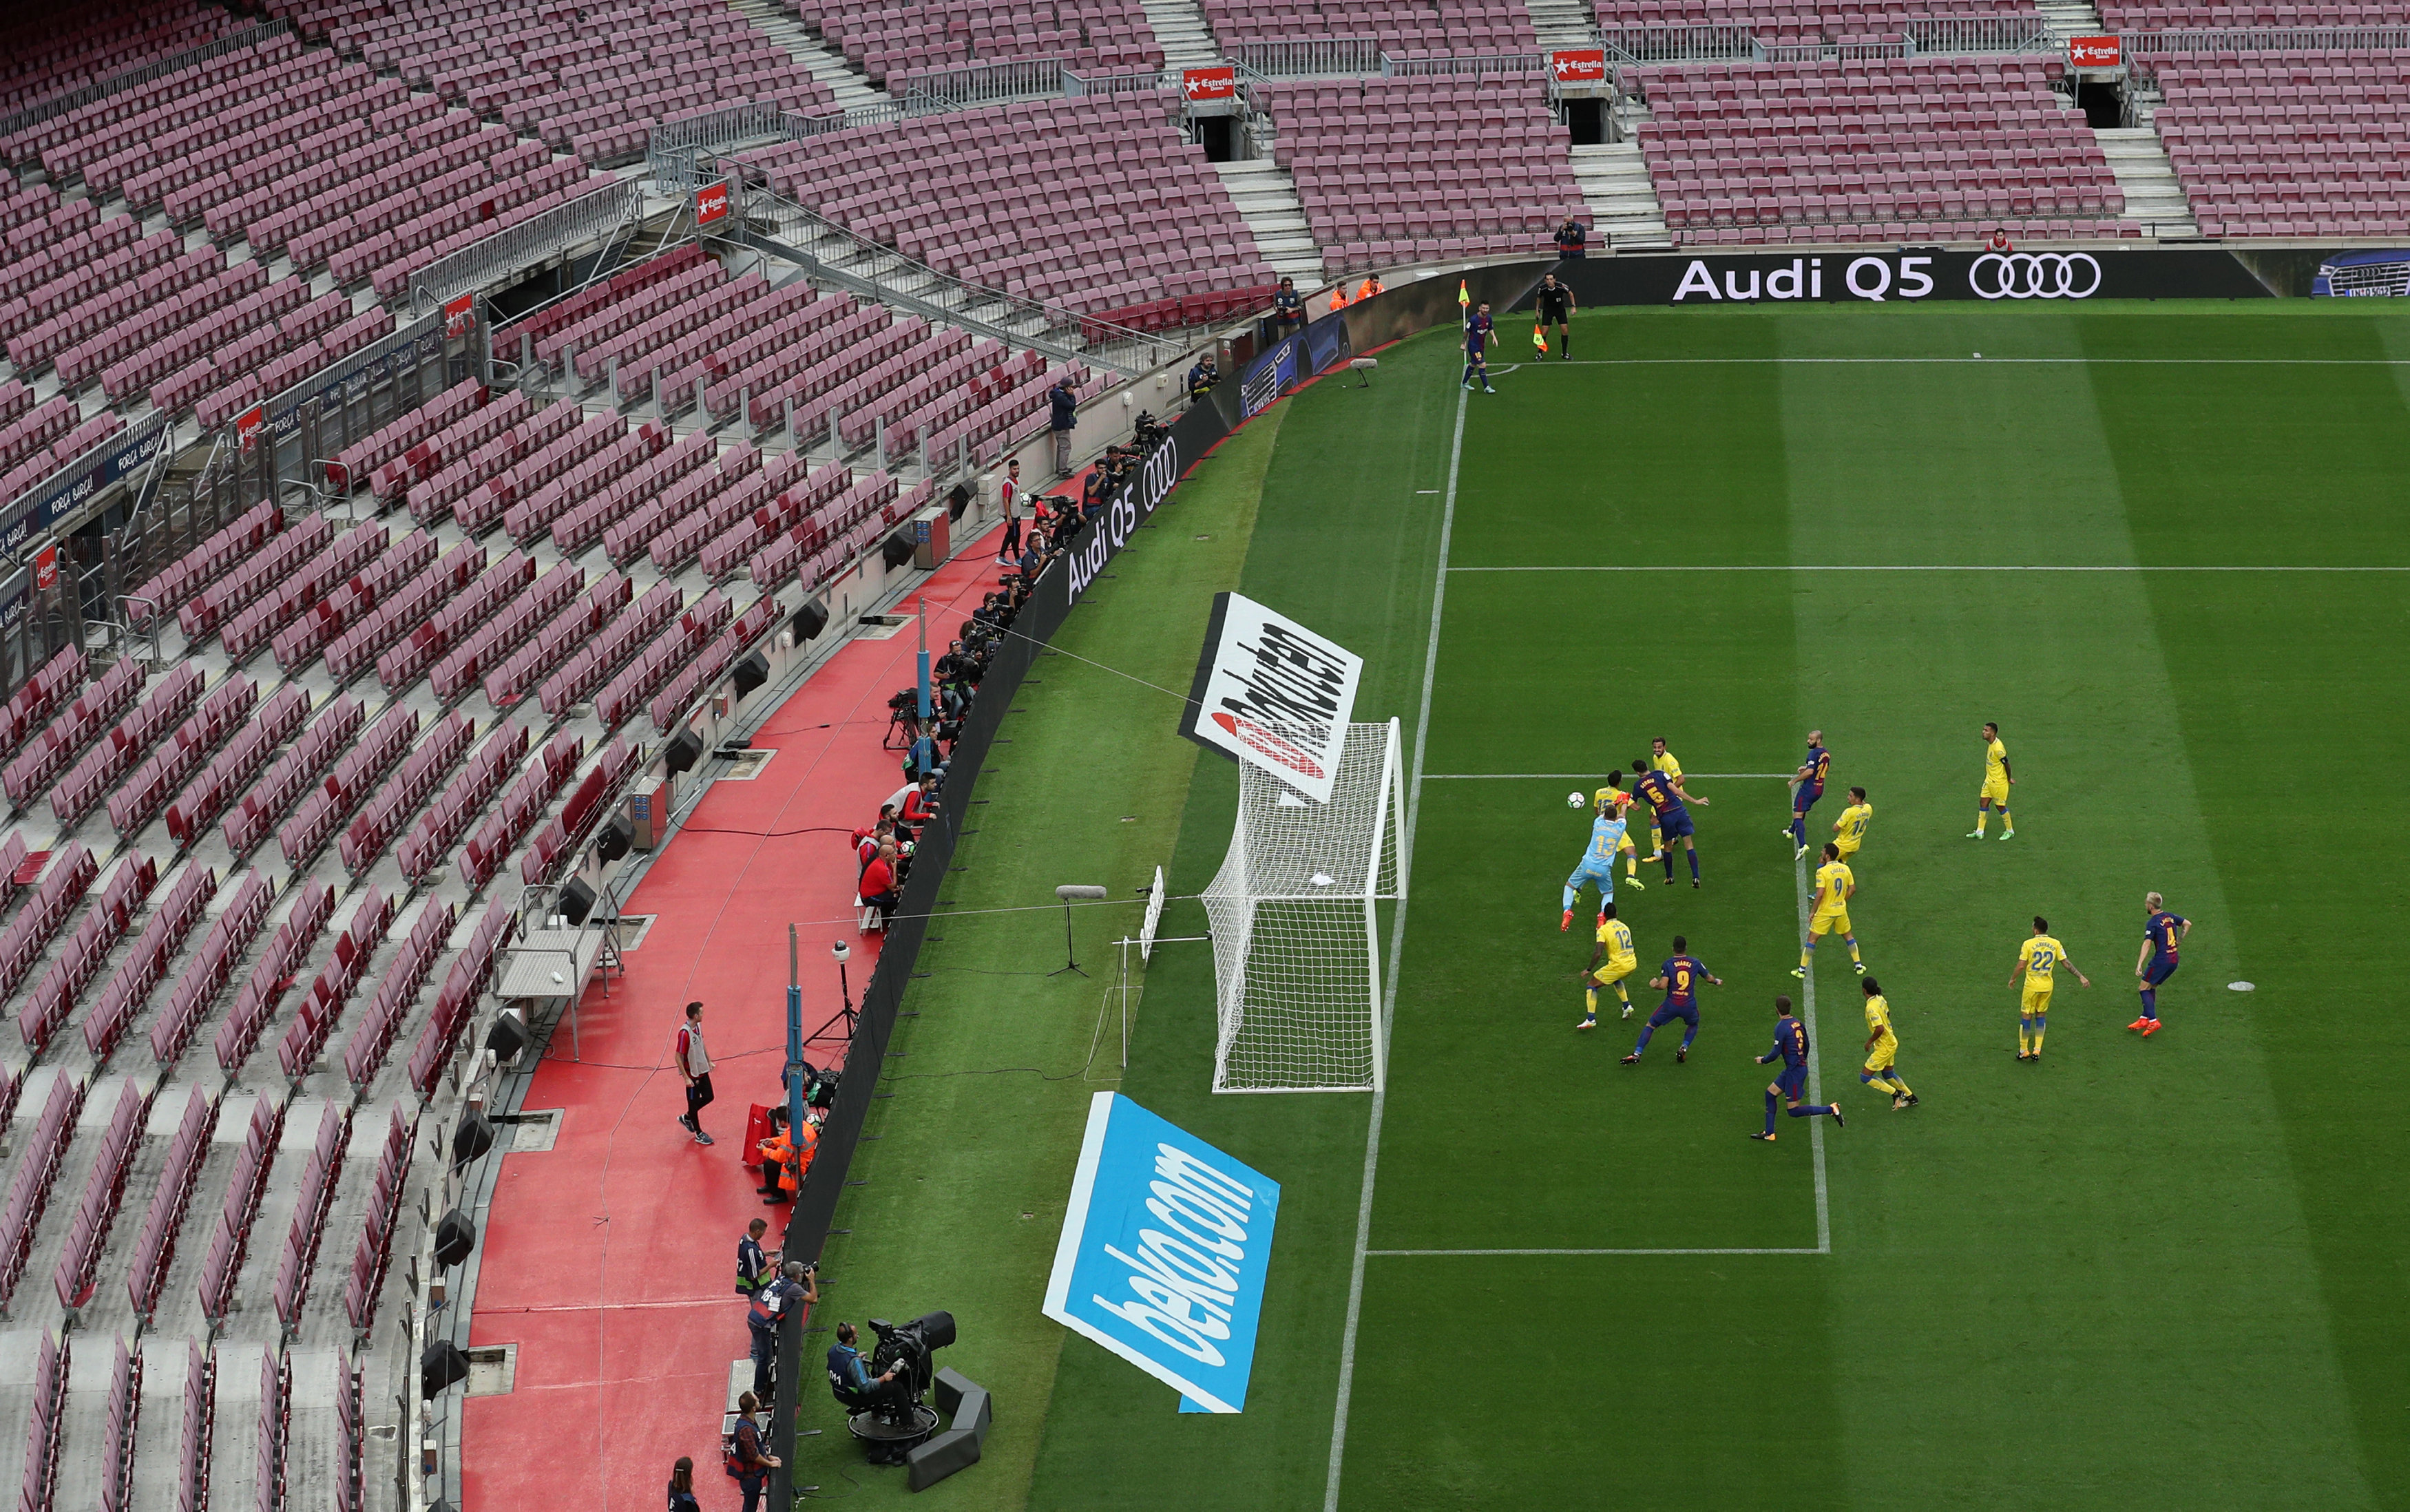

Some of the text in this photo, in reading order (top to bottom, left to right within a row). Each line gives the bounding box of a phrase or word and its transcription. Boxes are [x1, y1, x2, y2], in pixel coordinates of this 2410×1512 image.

[2087, 46, 2118, 55] Estrella
[1571, 60, 1602, 69] Estrella
[1201, 78, 1233, 87] Estrella
[1673, 256, 1934, 301] Audi Q5
[275, 413, 294, 433] FORÇA
[118, 432, 160, 471] FORÇA BARÇA!
[52, 474, 94, 514] FORÇA BARÇA!
[7, 519, 28, 547] BARÇA!
[1069, 482, 1135, 606] Audi Q5
[1221, 622, 1347, 760] Rakuten
[1647, 786, 1665, 804] 5
[1595, 835, 1617, 856] 13
[1835, 878, 1843, 897] 9
[1615, 930, 1634, 949] 12
[2167, 927, 2176, 947] 4
[2031, 951, 2053, 971] 22
[1677, 970, 1690, 990] 9
[1092, 1142, 1253, 1367] beko.com
[761, 1288, 773, 1302] 18
